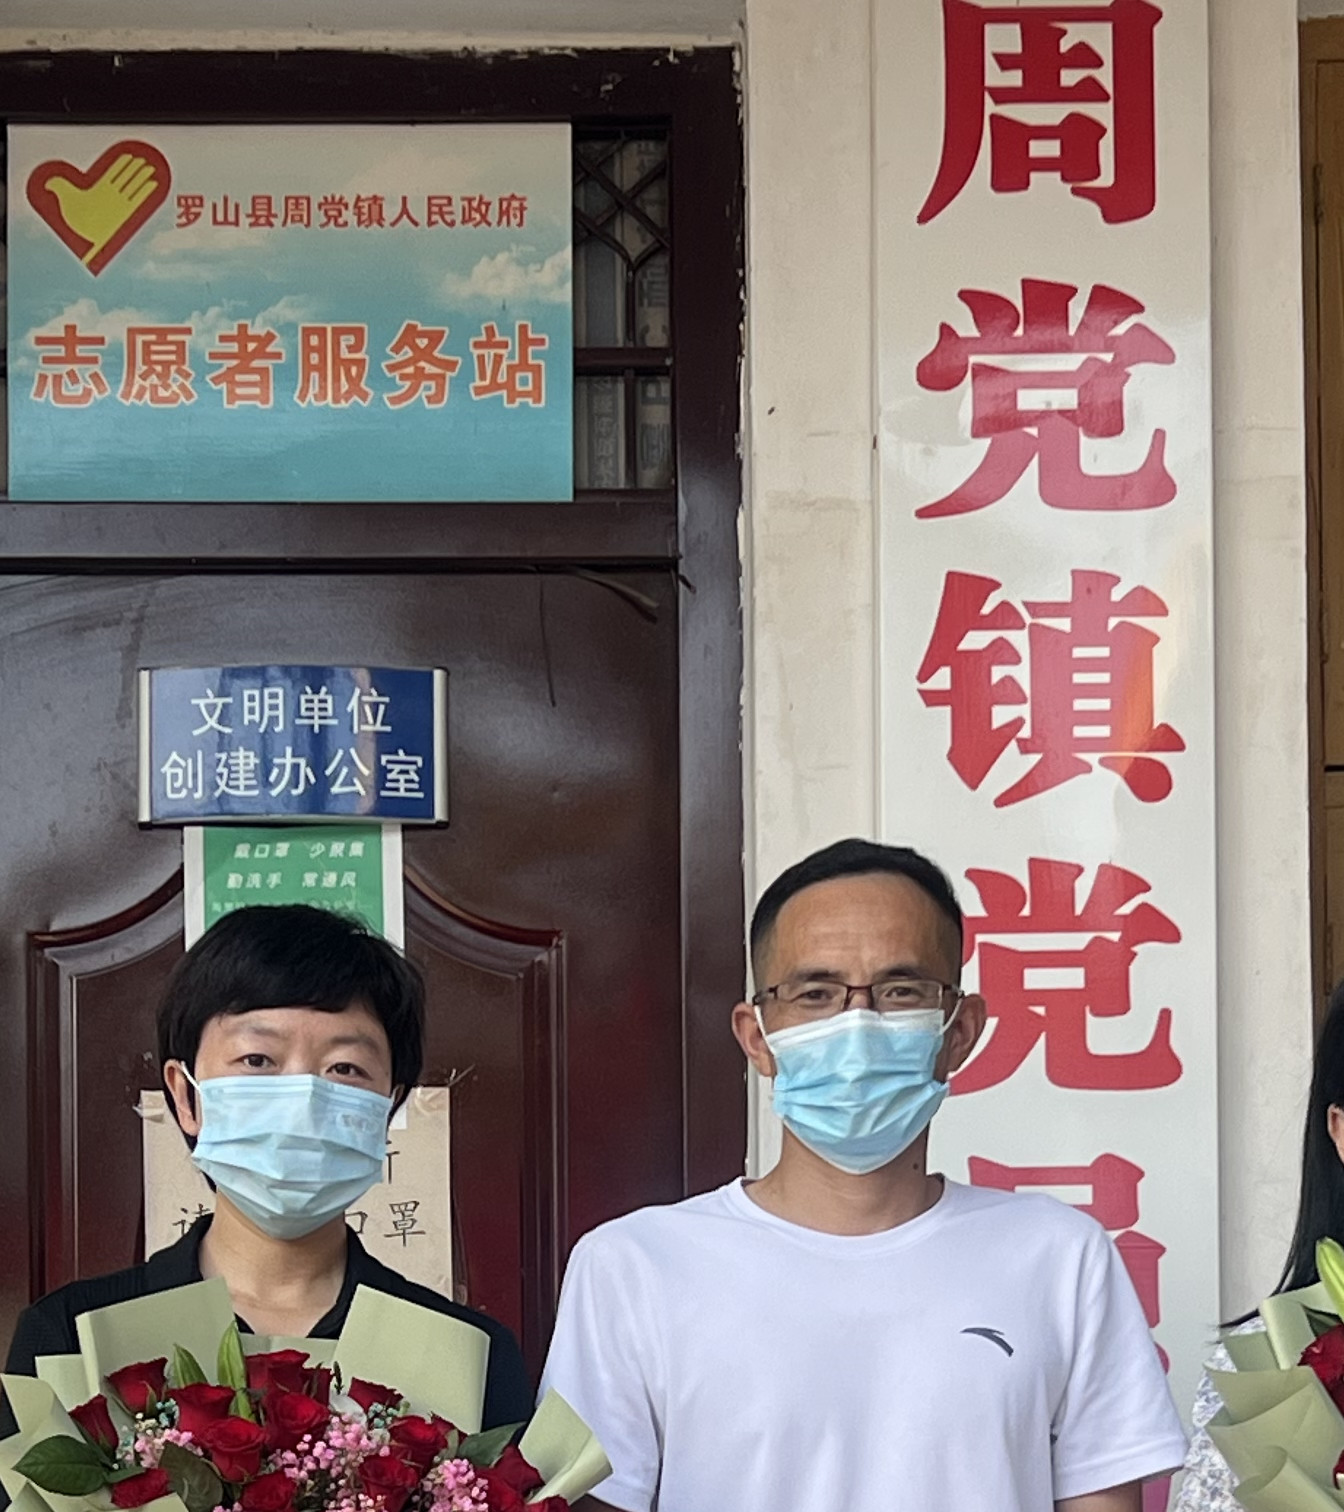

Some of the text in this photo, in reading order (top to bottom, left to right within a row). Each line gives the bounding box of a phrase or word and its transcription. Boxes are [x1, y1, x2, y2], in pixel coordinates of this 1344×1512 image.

[174, 193, 529, 229] 罗山县周党镇人民政府
[31, 320, 550, 409] 志愿者服务站
[191, 685, 393, 736] 文明单位
[160, 746, 425, 800] 创建办公室
